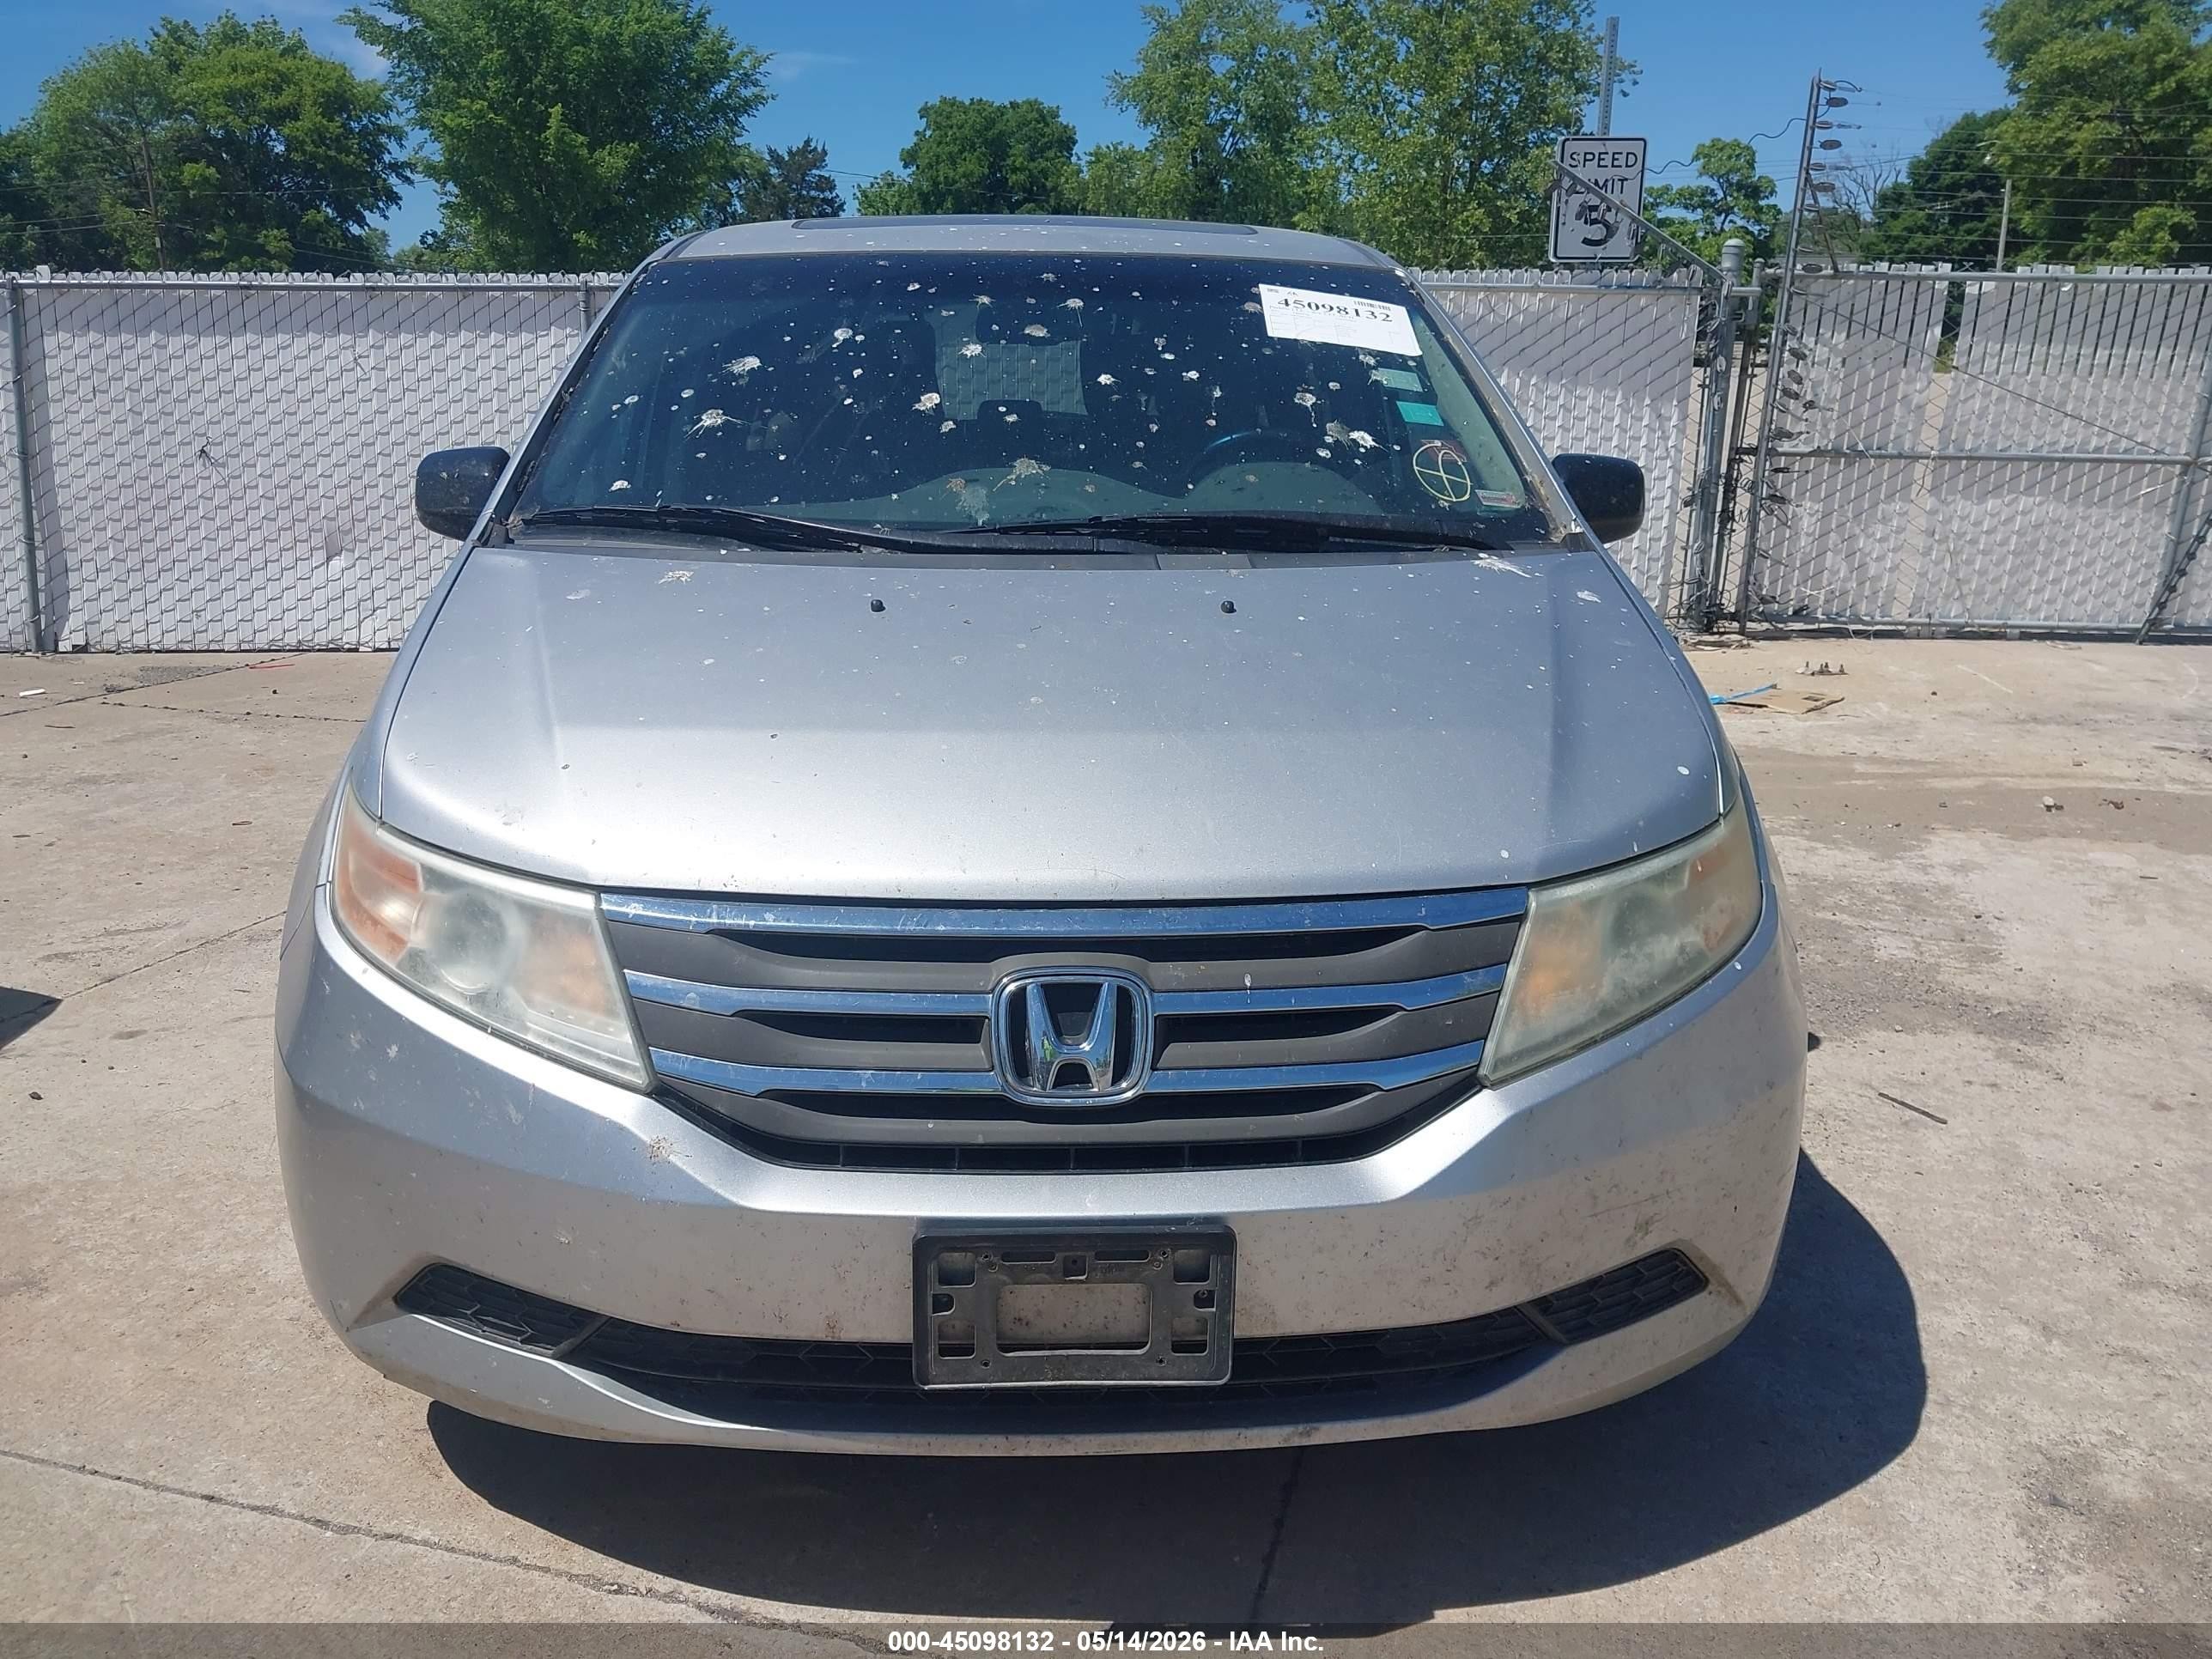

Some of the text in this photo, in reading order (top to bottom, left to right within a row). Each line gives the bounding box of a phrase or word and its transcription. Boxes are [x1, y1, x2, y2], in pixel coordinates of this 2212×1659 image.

[1568, 151, 1638, 168] SPEED
[1571, 178, 1629, 195] MIT
[1581, 204, 1614, 247] 5
[1277, 297, 1393, 323] 45098132
